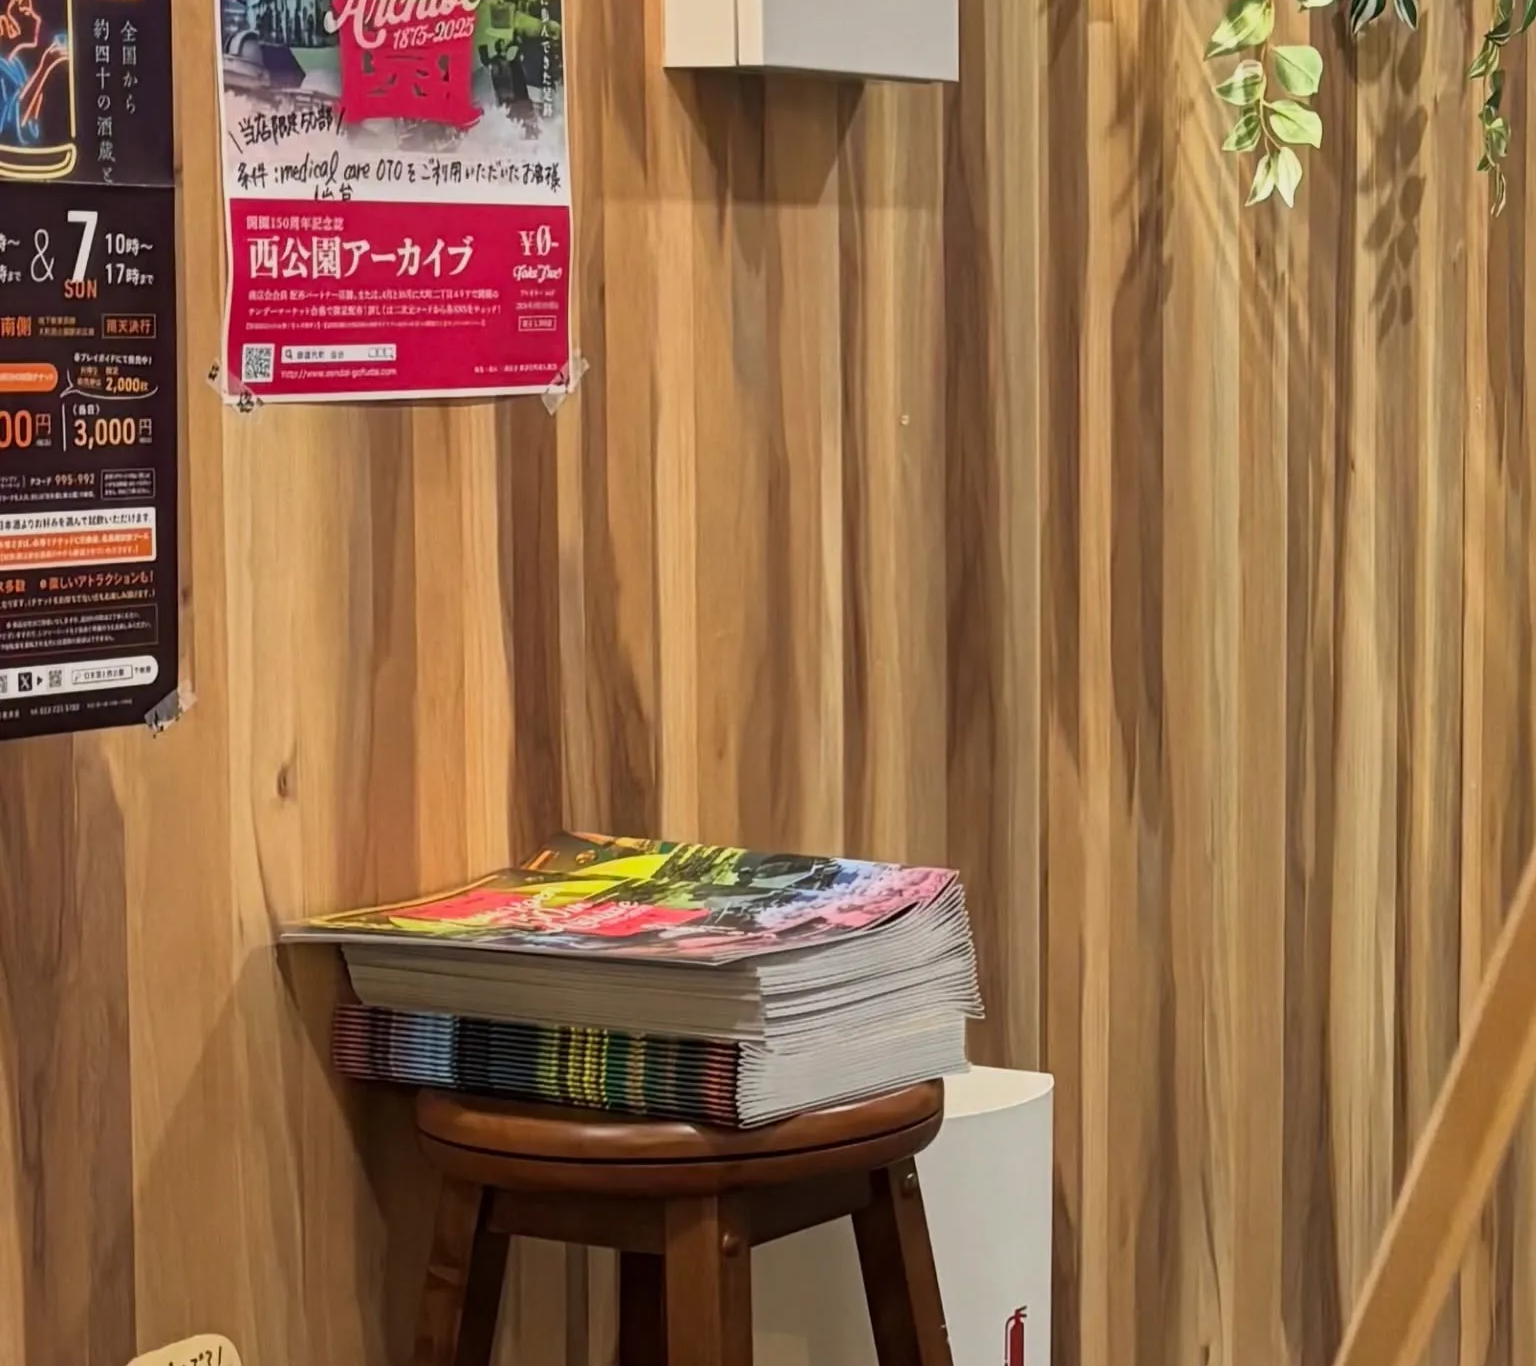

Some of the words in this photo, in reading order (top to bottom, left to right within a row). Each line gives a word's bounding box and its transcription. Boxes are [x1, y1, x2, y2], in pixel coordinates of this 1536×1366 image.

[393, 17, 476, 50] 1875-2025
[120, 20, 138, 114] 全国から
[247, 235, 474, 280] 西公園アーカイブ
[64, 278, 97, 299] SUN
